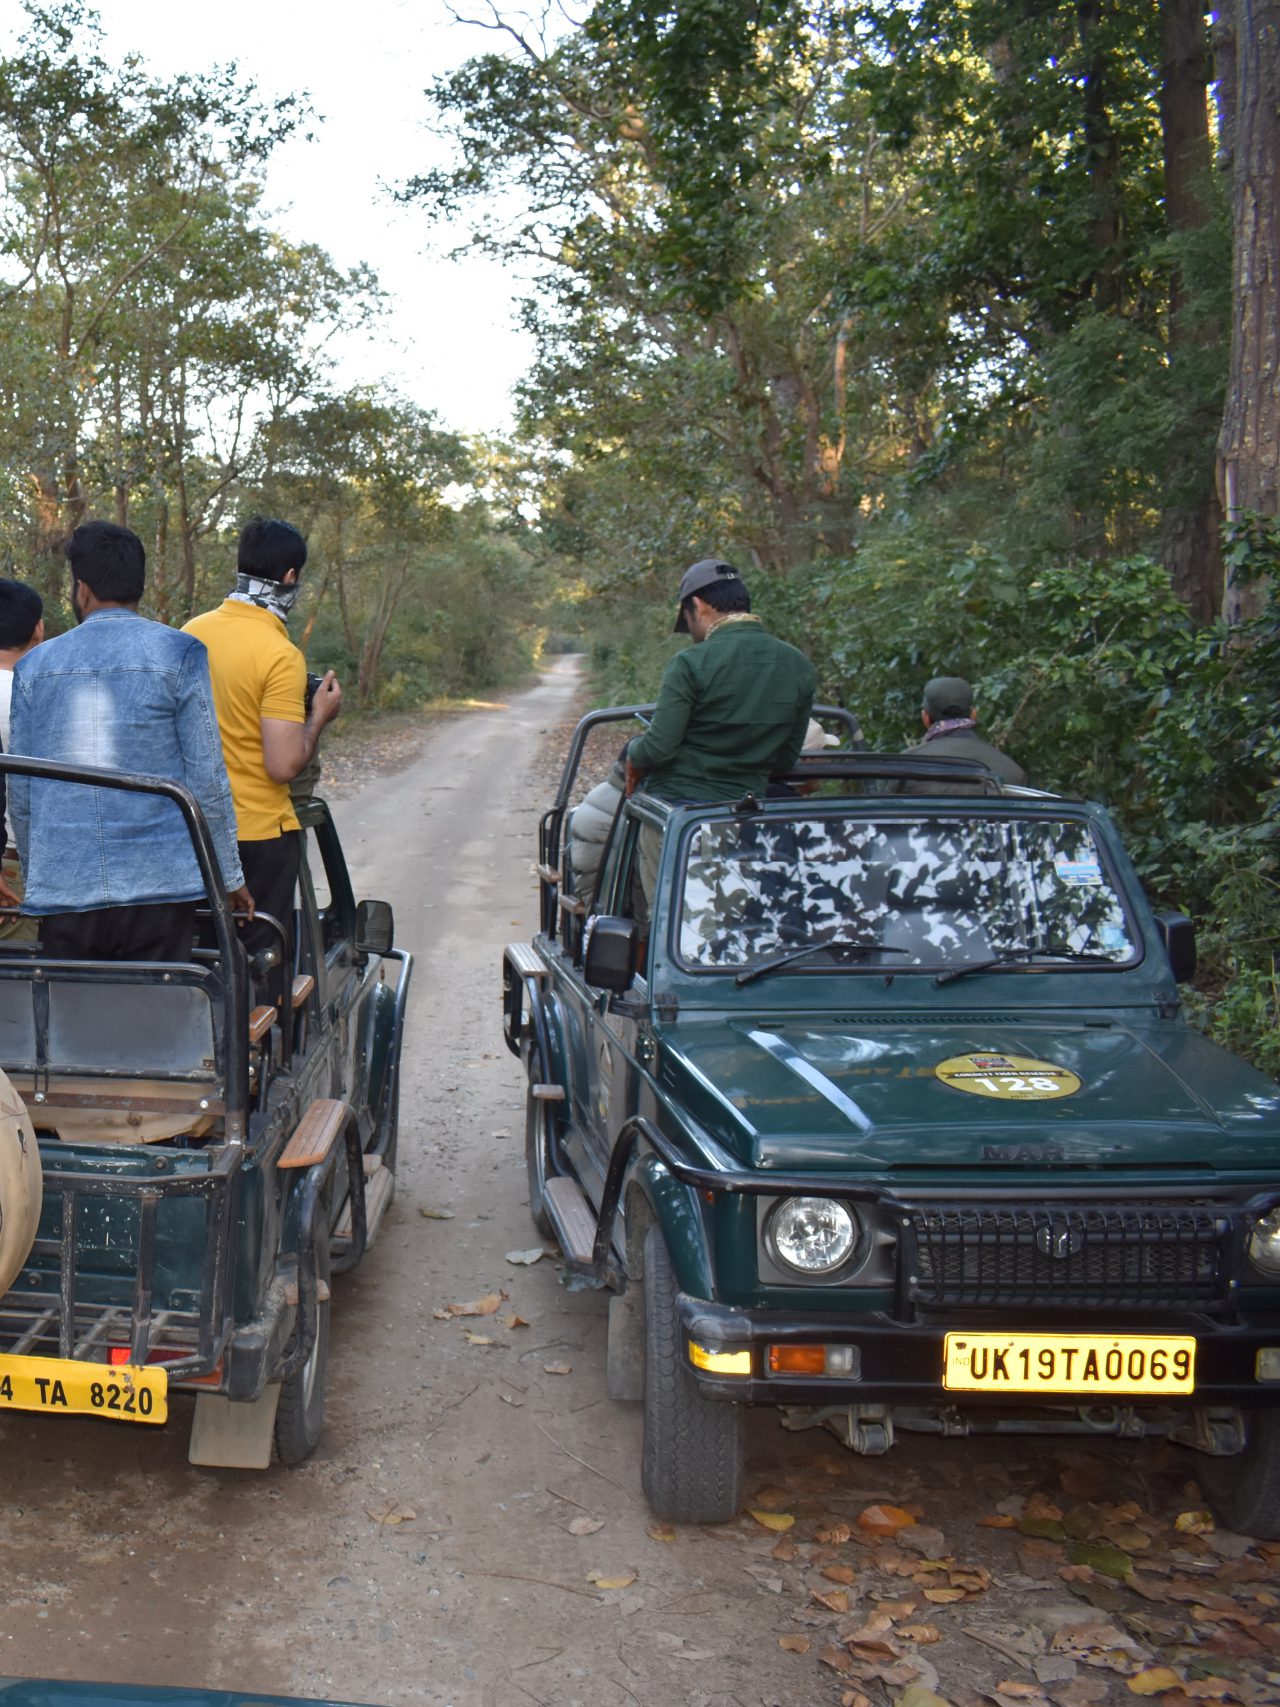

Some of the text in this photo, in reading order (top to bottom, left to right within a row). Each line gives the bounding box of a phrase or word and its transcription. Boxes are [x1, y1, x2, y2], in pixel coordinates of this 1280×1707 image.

[974, 1077, 1061, 1092] 128
[970, 1348, 1190, 1380] UK19TA0069
[35, 1377, 68, 1406] TA
[90, 1382, 153, 1415] 8220
